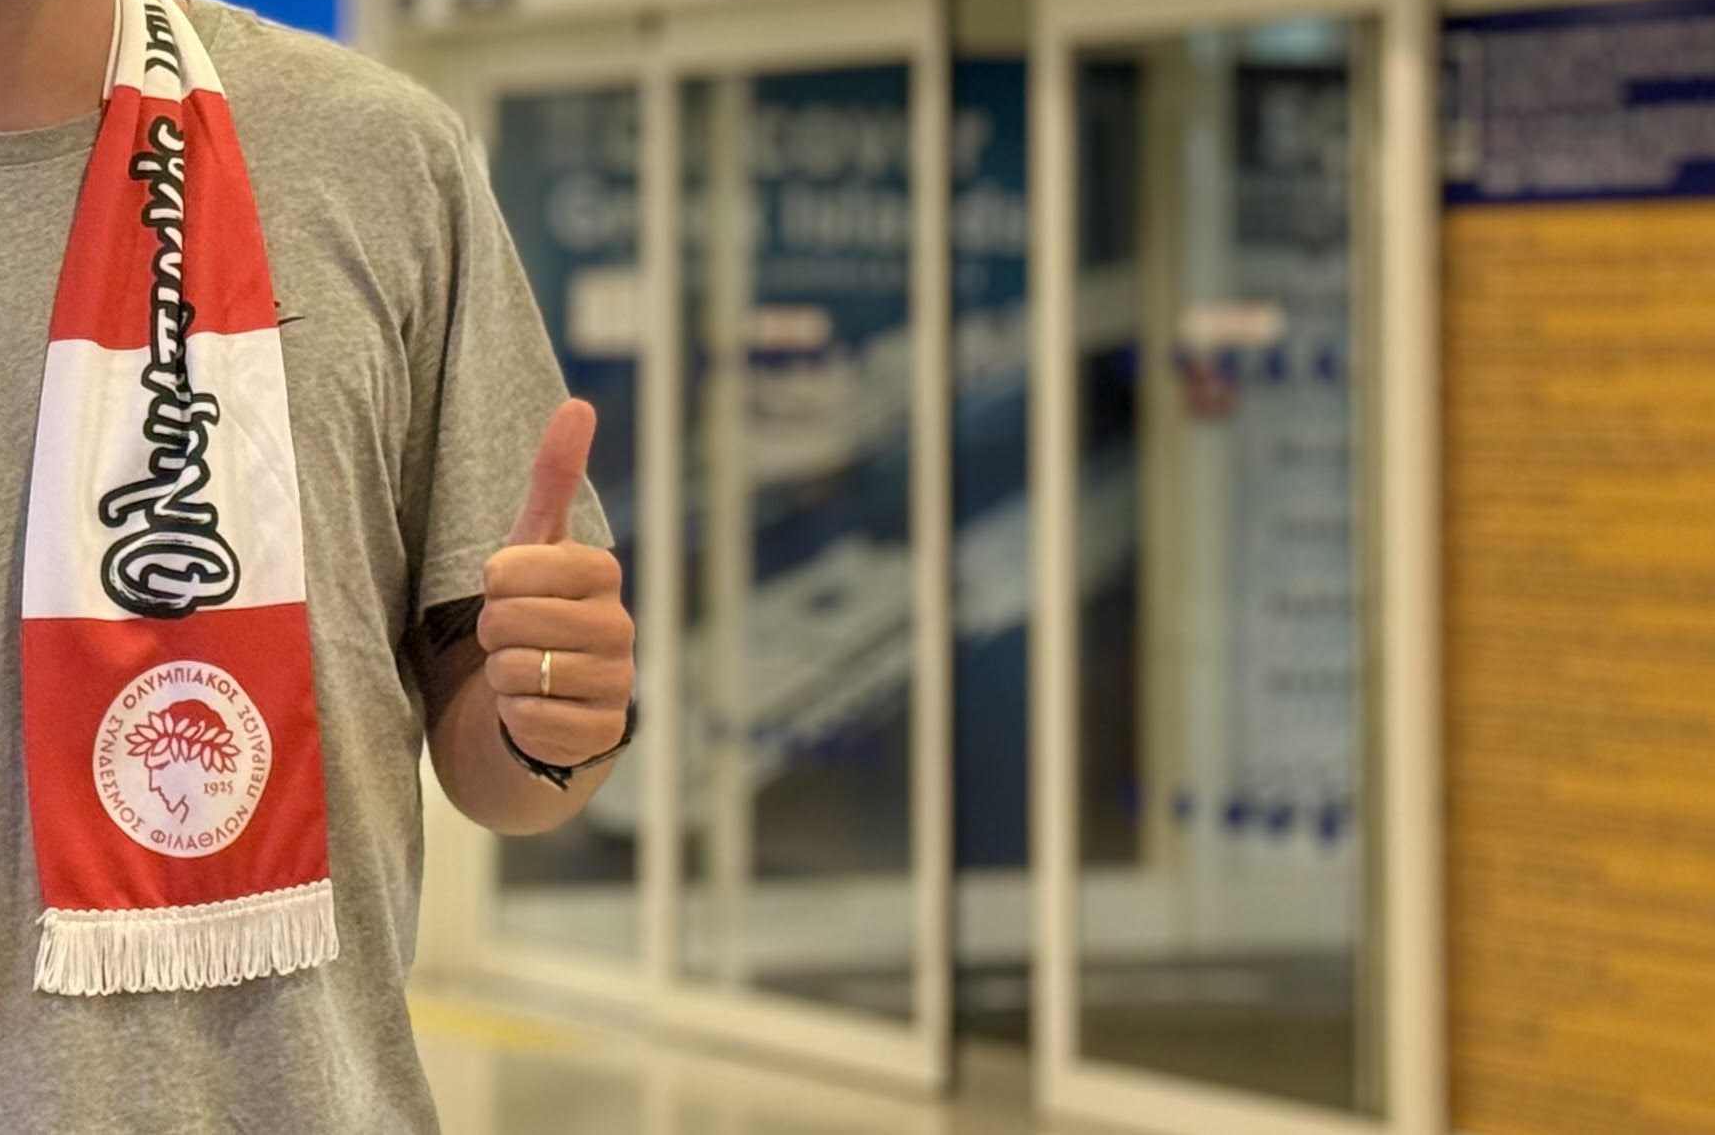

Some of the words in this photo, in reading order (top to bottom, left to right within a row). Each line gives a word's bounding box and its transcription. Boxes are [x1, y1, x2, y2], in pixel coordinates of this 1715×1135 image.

[122, 667, 240, 711] ΟΛΥΜΠΙΑΚΟΣ
[99, 714, 146, 833] ΣΥΝΔΕΣΜΟΣ
[150, 805, 250, 851] ΦΙΛΑΘΛΩΝ
[236, 704, 267, 799] ΠΕΙΡΑΙΩΣ
[202, 780, 234, 797] 1925
